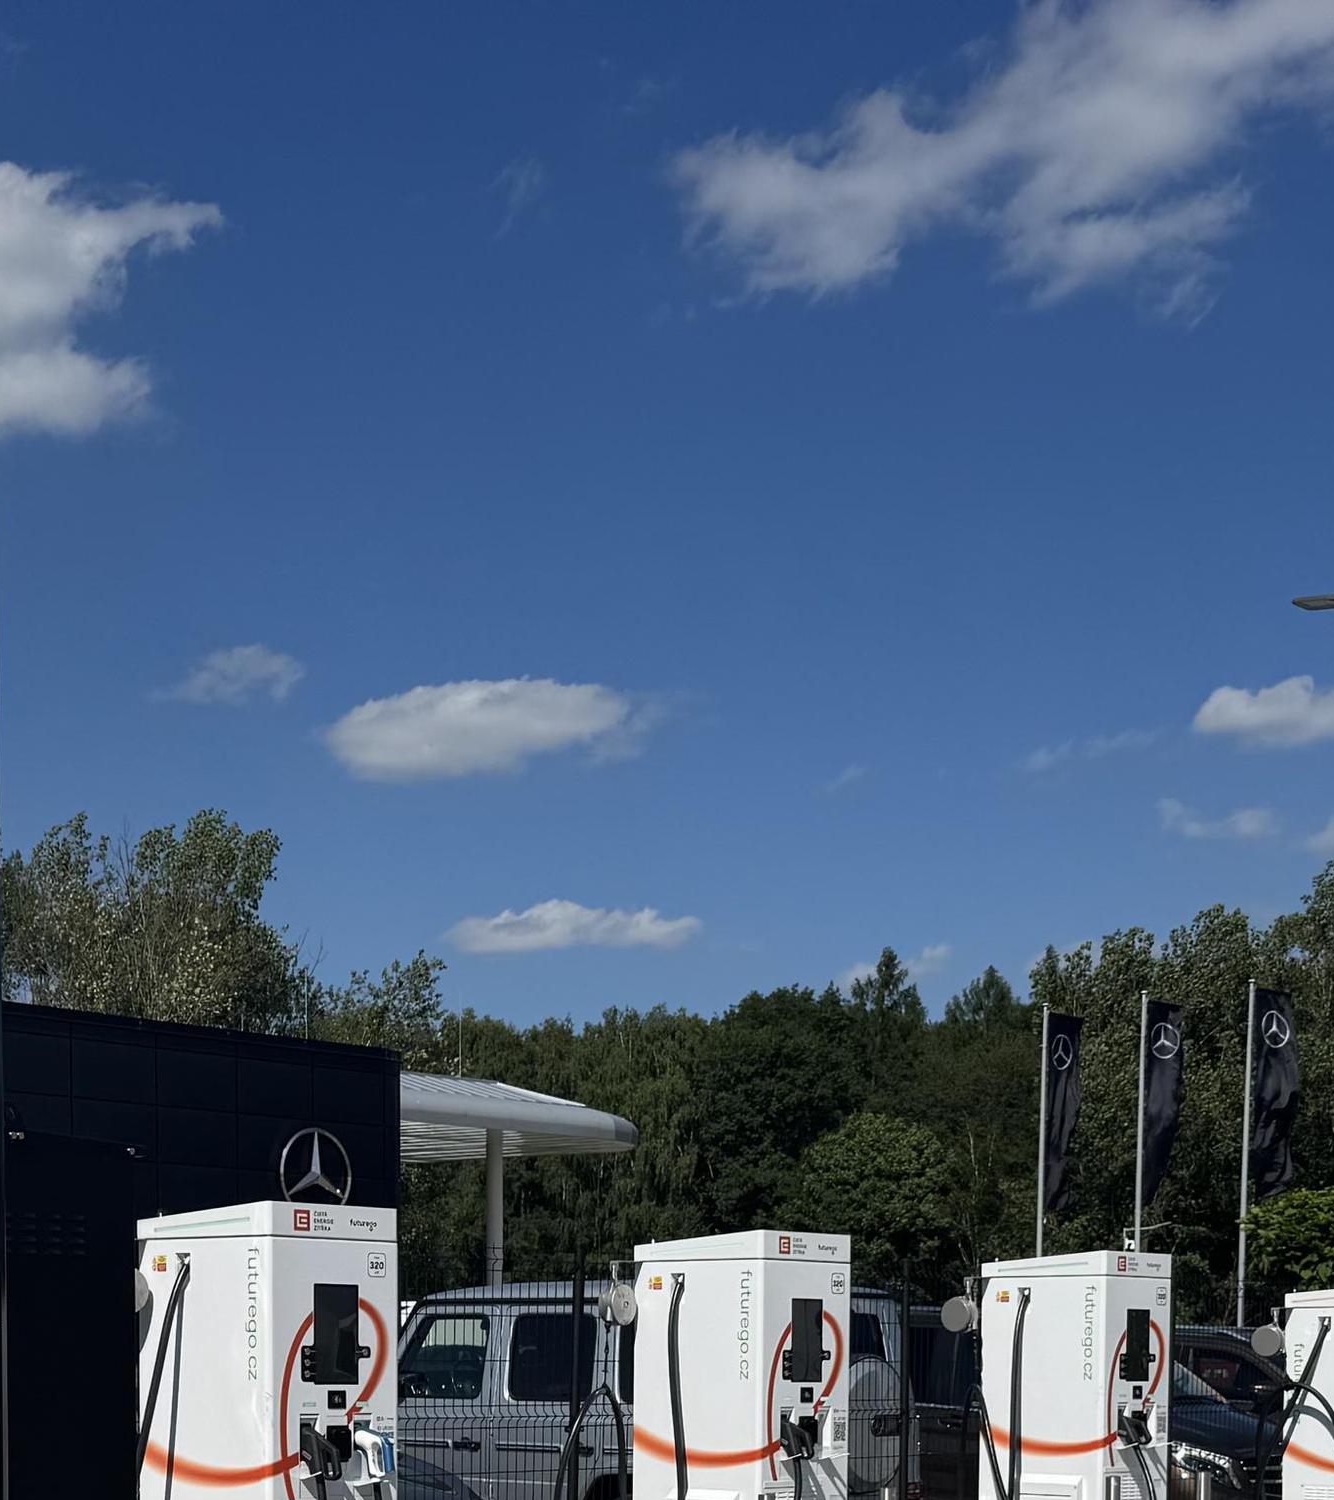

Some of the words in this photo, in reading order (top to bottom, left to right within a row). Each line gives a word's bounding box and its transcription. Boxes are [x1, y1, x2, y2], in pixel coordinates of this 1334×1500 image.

[245, 1248, 259, 1381] futurego.cz
[370, 1261, 384, 1270] 320
[737, 1270, 753, 1381] futurego.cz
[1081, 1285, 1097, 1381] futurego.cz
